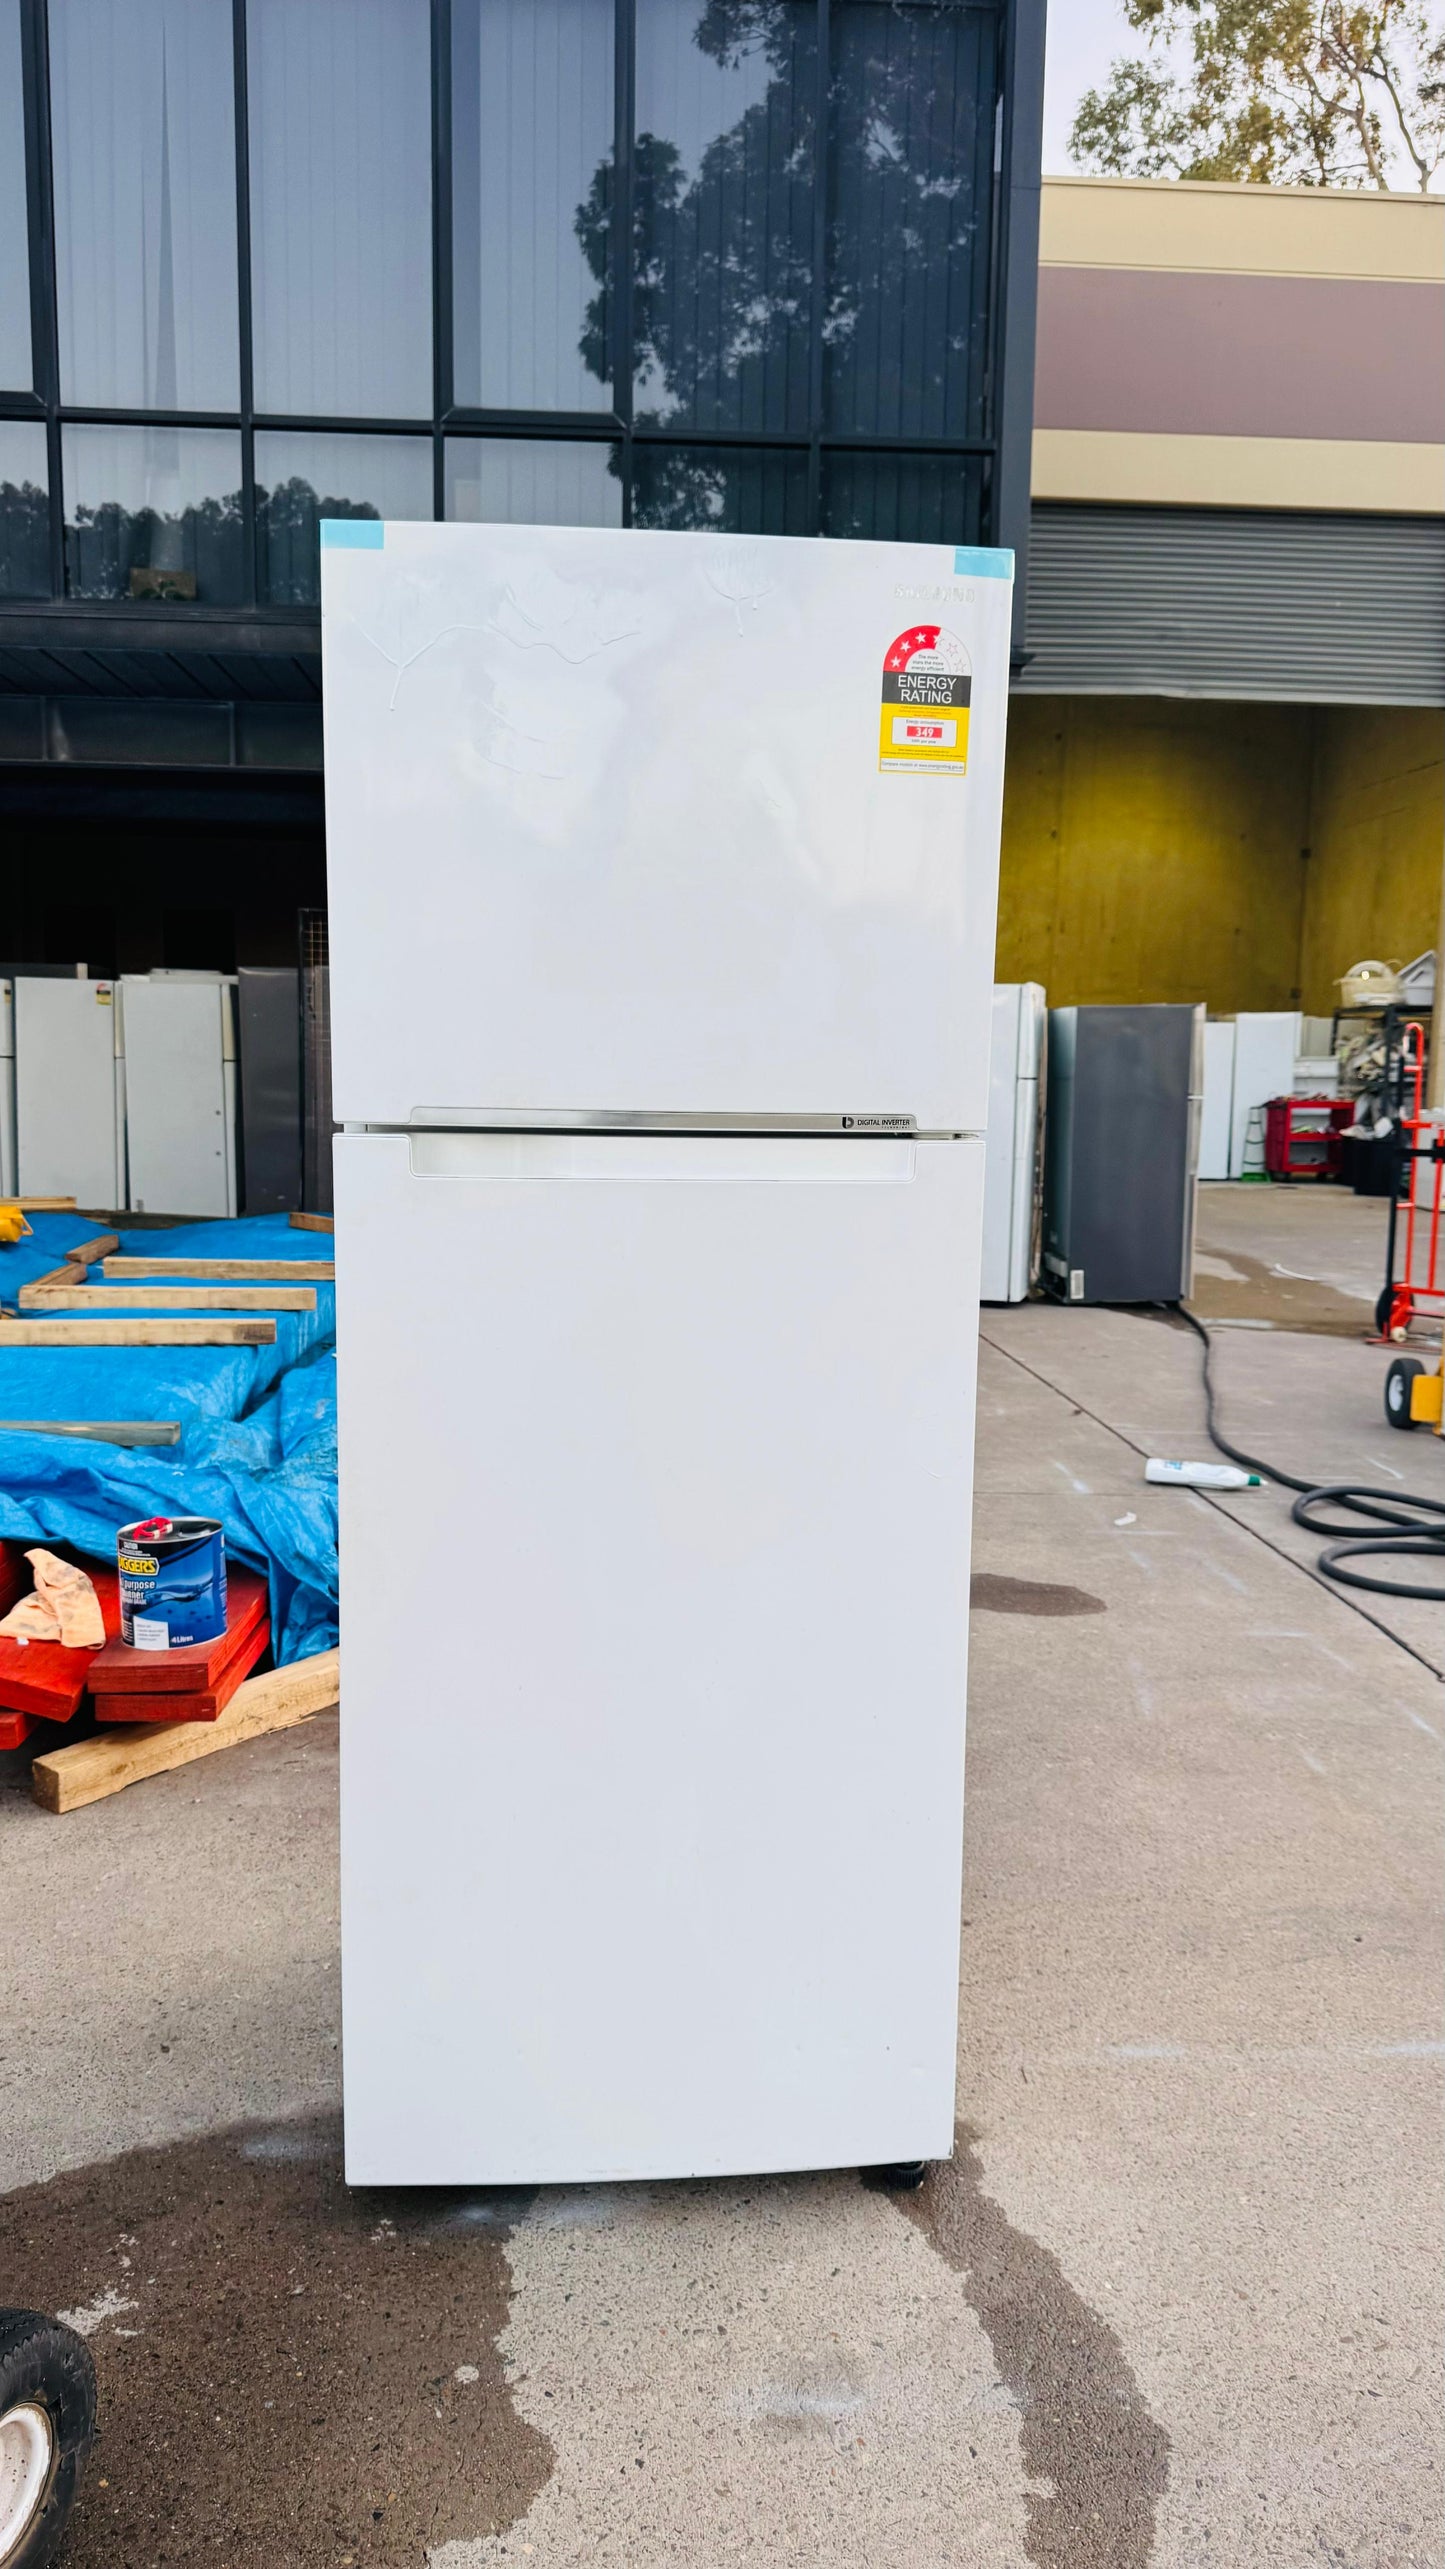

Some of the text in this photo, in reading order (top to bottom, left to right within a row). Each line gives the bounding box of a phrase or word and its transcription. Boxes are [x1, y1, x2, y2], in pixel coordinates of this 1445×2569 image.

[898, 674, 957, 690] ENERGY
[901, 689, 952, 704] RATING
[915, 727, 934, 738] 349
[857, 1118, 880, 1126] DIGITAL
